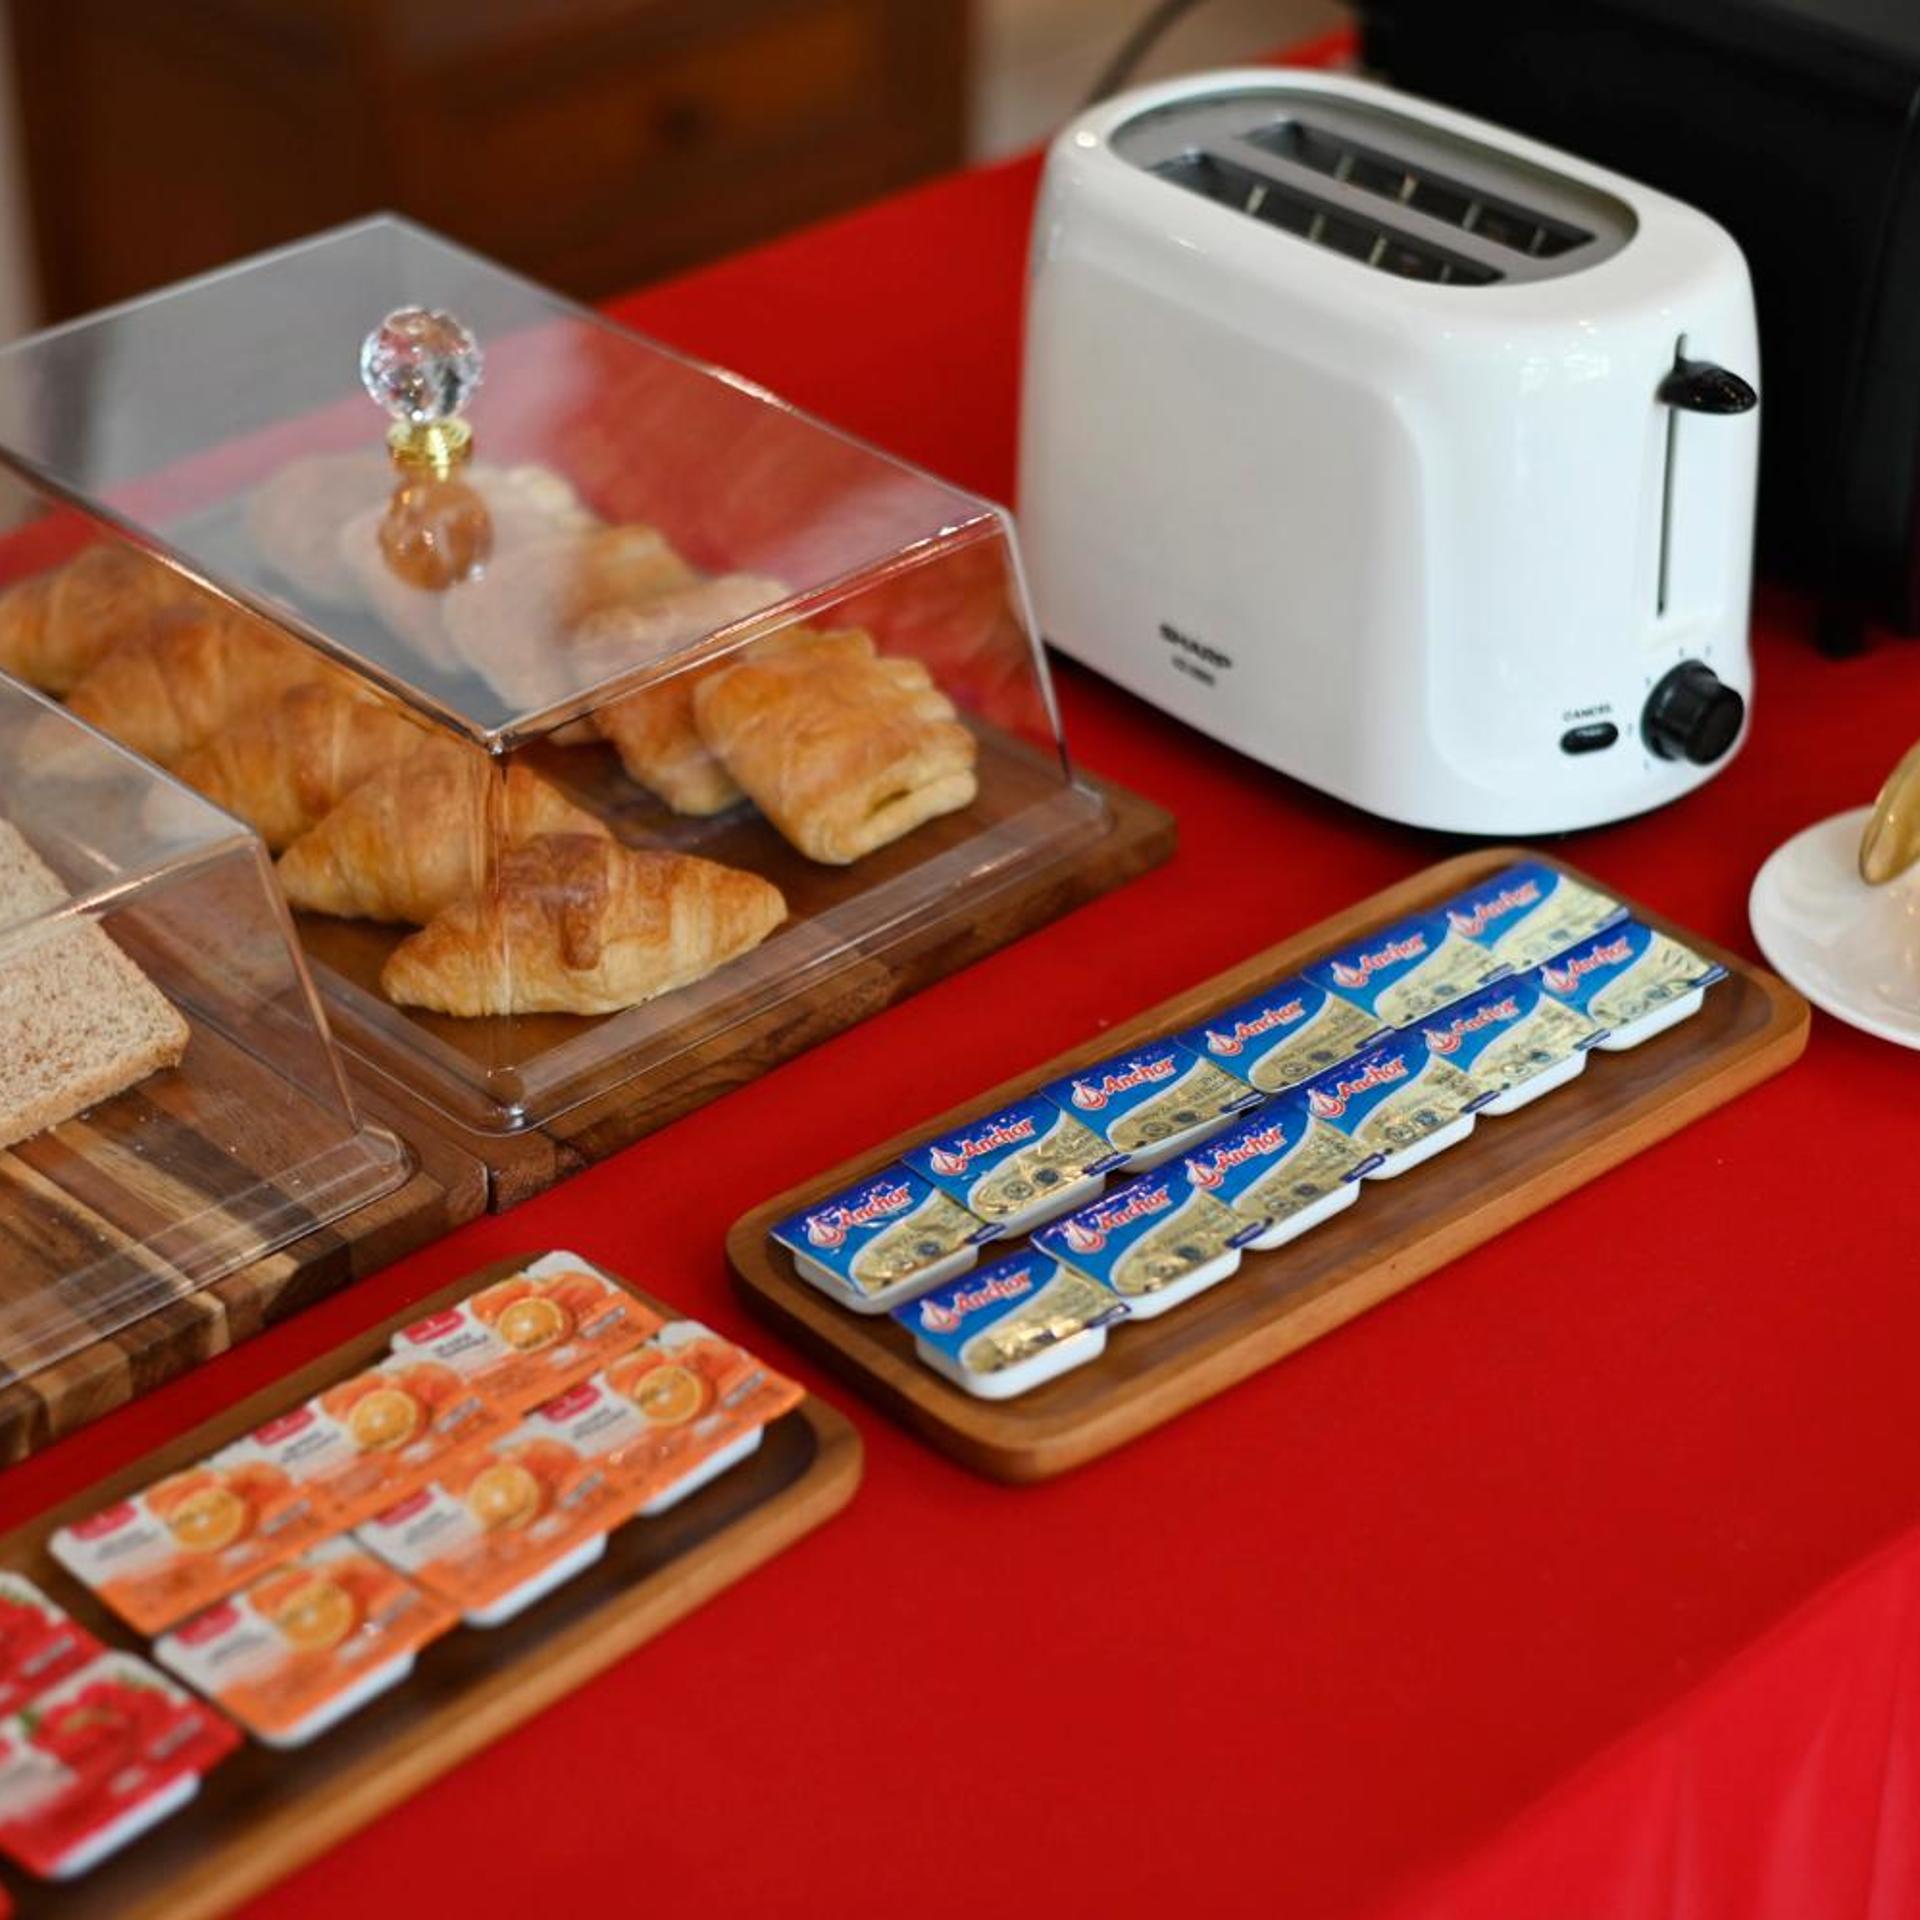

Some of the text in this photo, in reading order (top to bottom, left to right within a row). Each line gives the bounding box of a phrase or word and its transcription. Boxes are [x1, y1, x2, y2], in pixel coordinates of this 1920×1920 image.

[1160, 623, 1232, 669] SHARP
[1235, 1001, 1304, 1040] Anchor
[1103, 1057, 1176, 1094] Anchor
[1338, 1058, 1408, 1099] Anchor
[962, 1118, 1034, 1157] Anchor
[1216, 1127, 1286, 1170] Anchor
[838, 1186, 911, 1227] Anchor
[1098, 1189, 1171, 1232] Anchor
[954, 1270, 1032, 1312] Anchor
